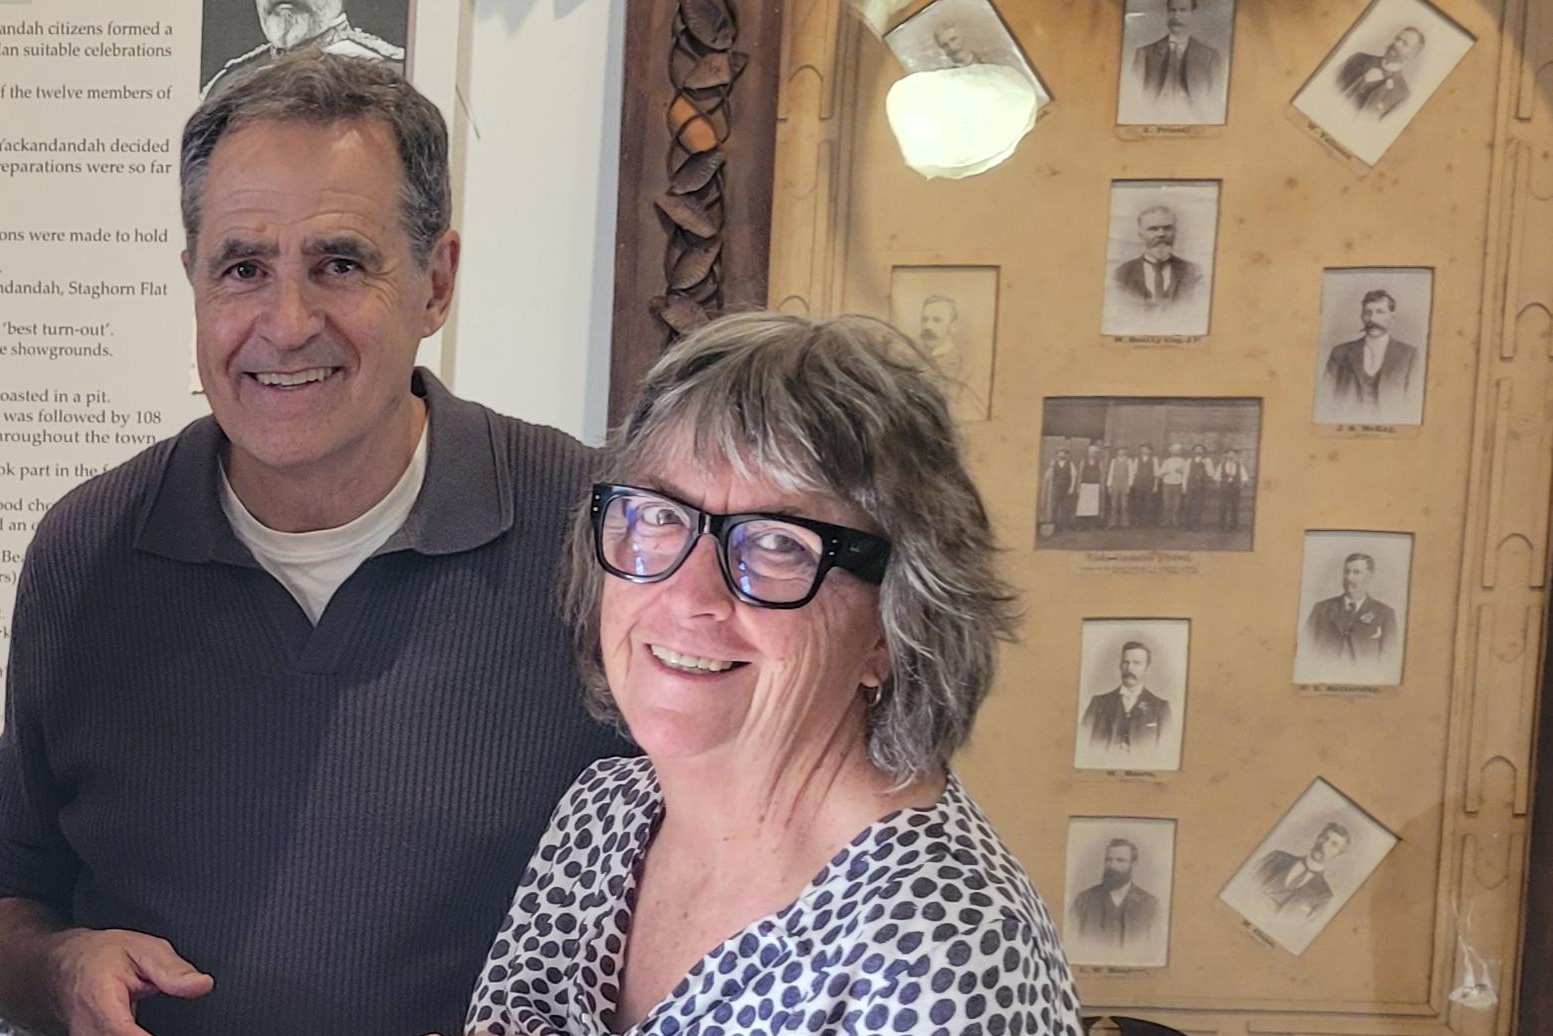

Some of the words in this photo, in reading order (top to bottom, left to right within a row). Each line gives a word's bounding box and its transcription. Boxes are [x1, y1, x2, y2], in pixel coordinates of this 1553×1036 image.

[47, 21, 104, 36] citizens
[106, 21, 161, 36] formed
[164, 24, 173, 36] a
[22, 41, 81, 58] suitable
[83, 41, 173, 58] celebrations
[109, 137, 170, 153] decided
[28, 231, 66, 242] were
[69, 227, 112, 243] made
[115, 229, 131, 243] to
[133, 227, 169, 244] hold
[53, 388, 69, 404] in
[72, 392, 82, 404] a
[85, 389, 111, 408] pit.
